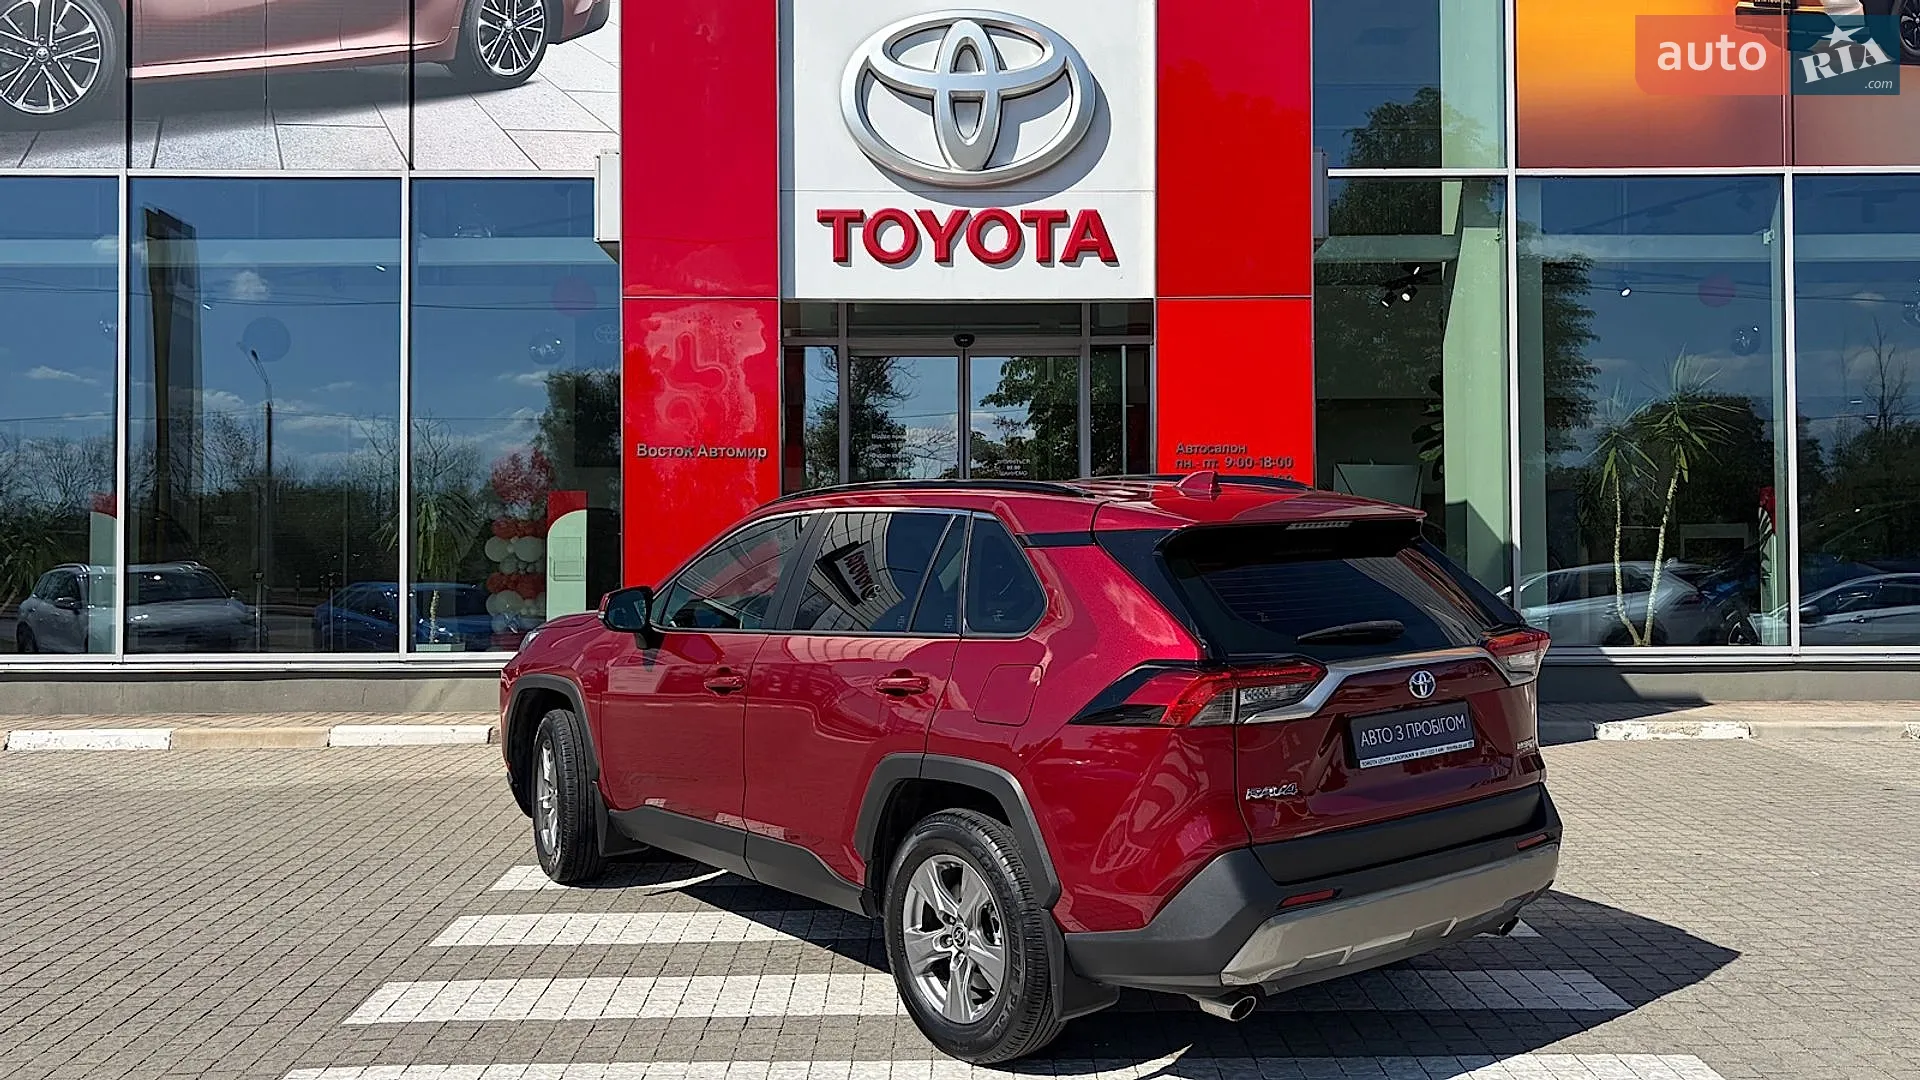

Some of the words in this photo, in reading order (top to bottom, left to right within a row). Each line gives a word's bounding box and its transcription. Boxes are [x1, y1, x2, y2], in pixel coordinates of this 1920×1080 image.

[816, 207, 1120, 264] TOYOTA
[636, 443, 694, 458] Восток
[697, 444, 768, 460] Автомир
[1176, 443, 1247, 455] Автосалон
[1360, 727, 1394, 748] АВТО
[1405, 713, 1467, 740] ПРОБІГОМ
